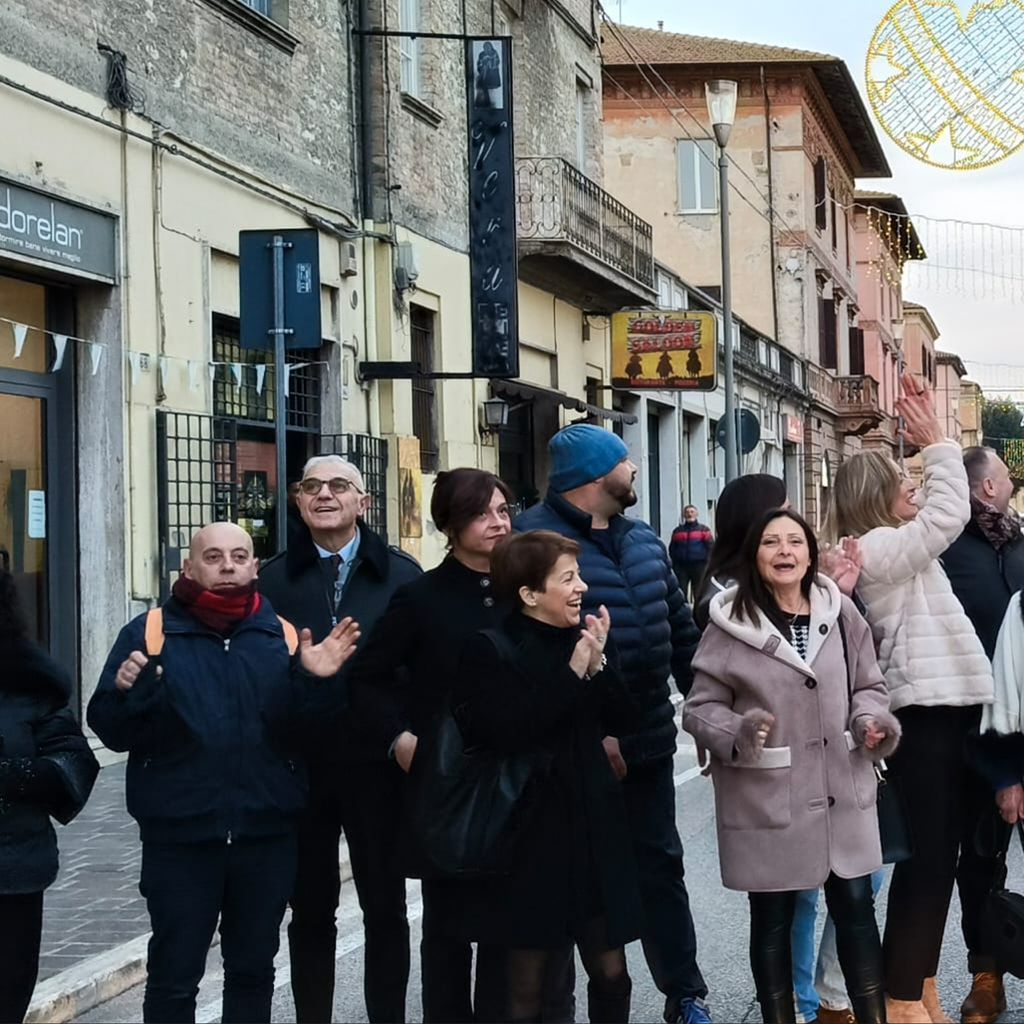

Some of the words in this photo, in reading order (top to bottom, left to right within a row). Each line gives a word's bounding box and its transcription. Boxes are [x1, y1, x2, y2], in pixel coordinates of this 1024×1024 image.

[0, 188, 81, 250] dorelan
[630, 319, 696, 333] GOLDEN
[631, 334, 696, 353] SALOON
